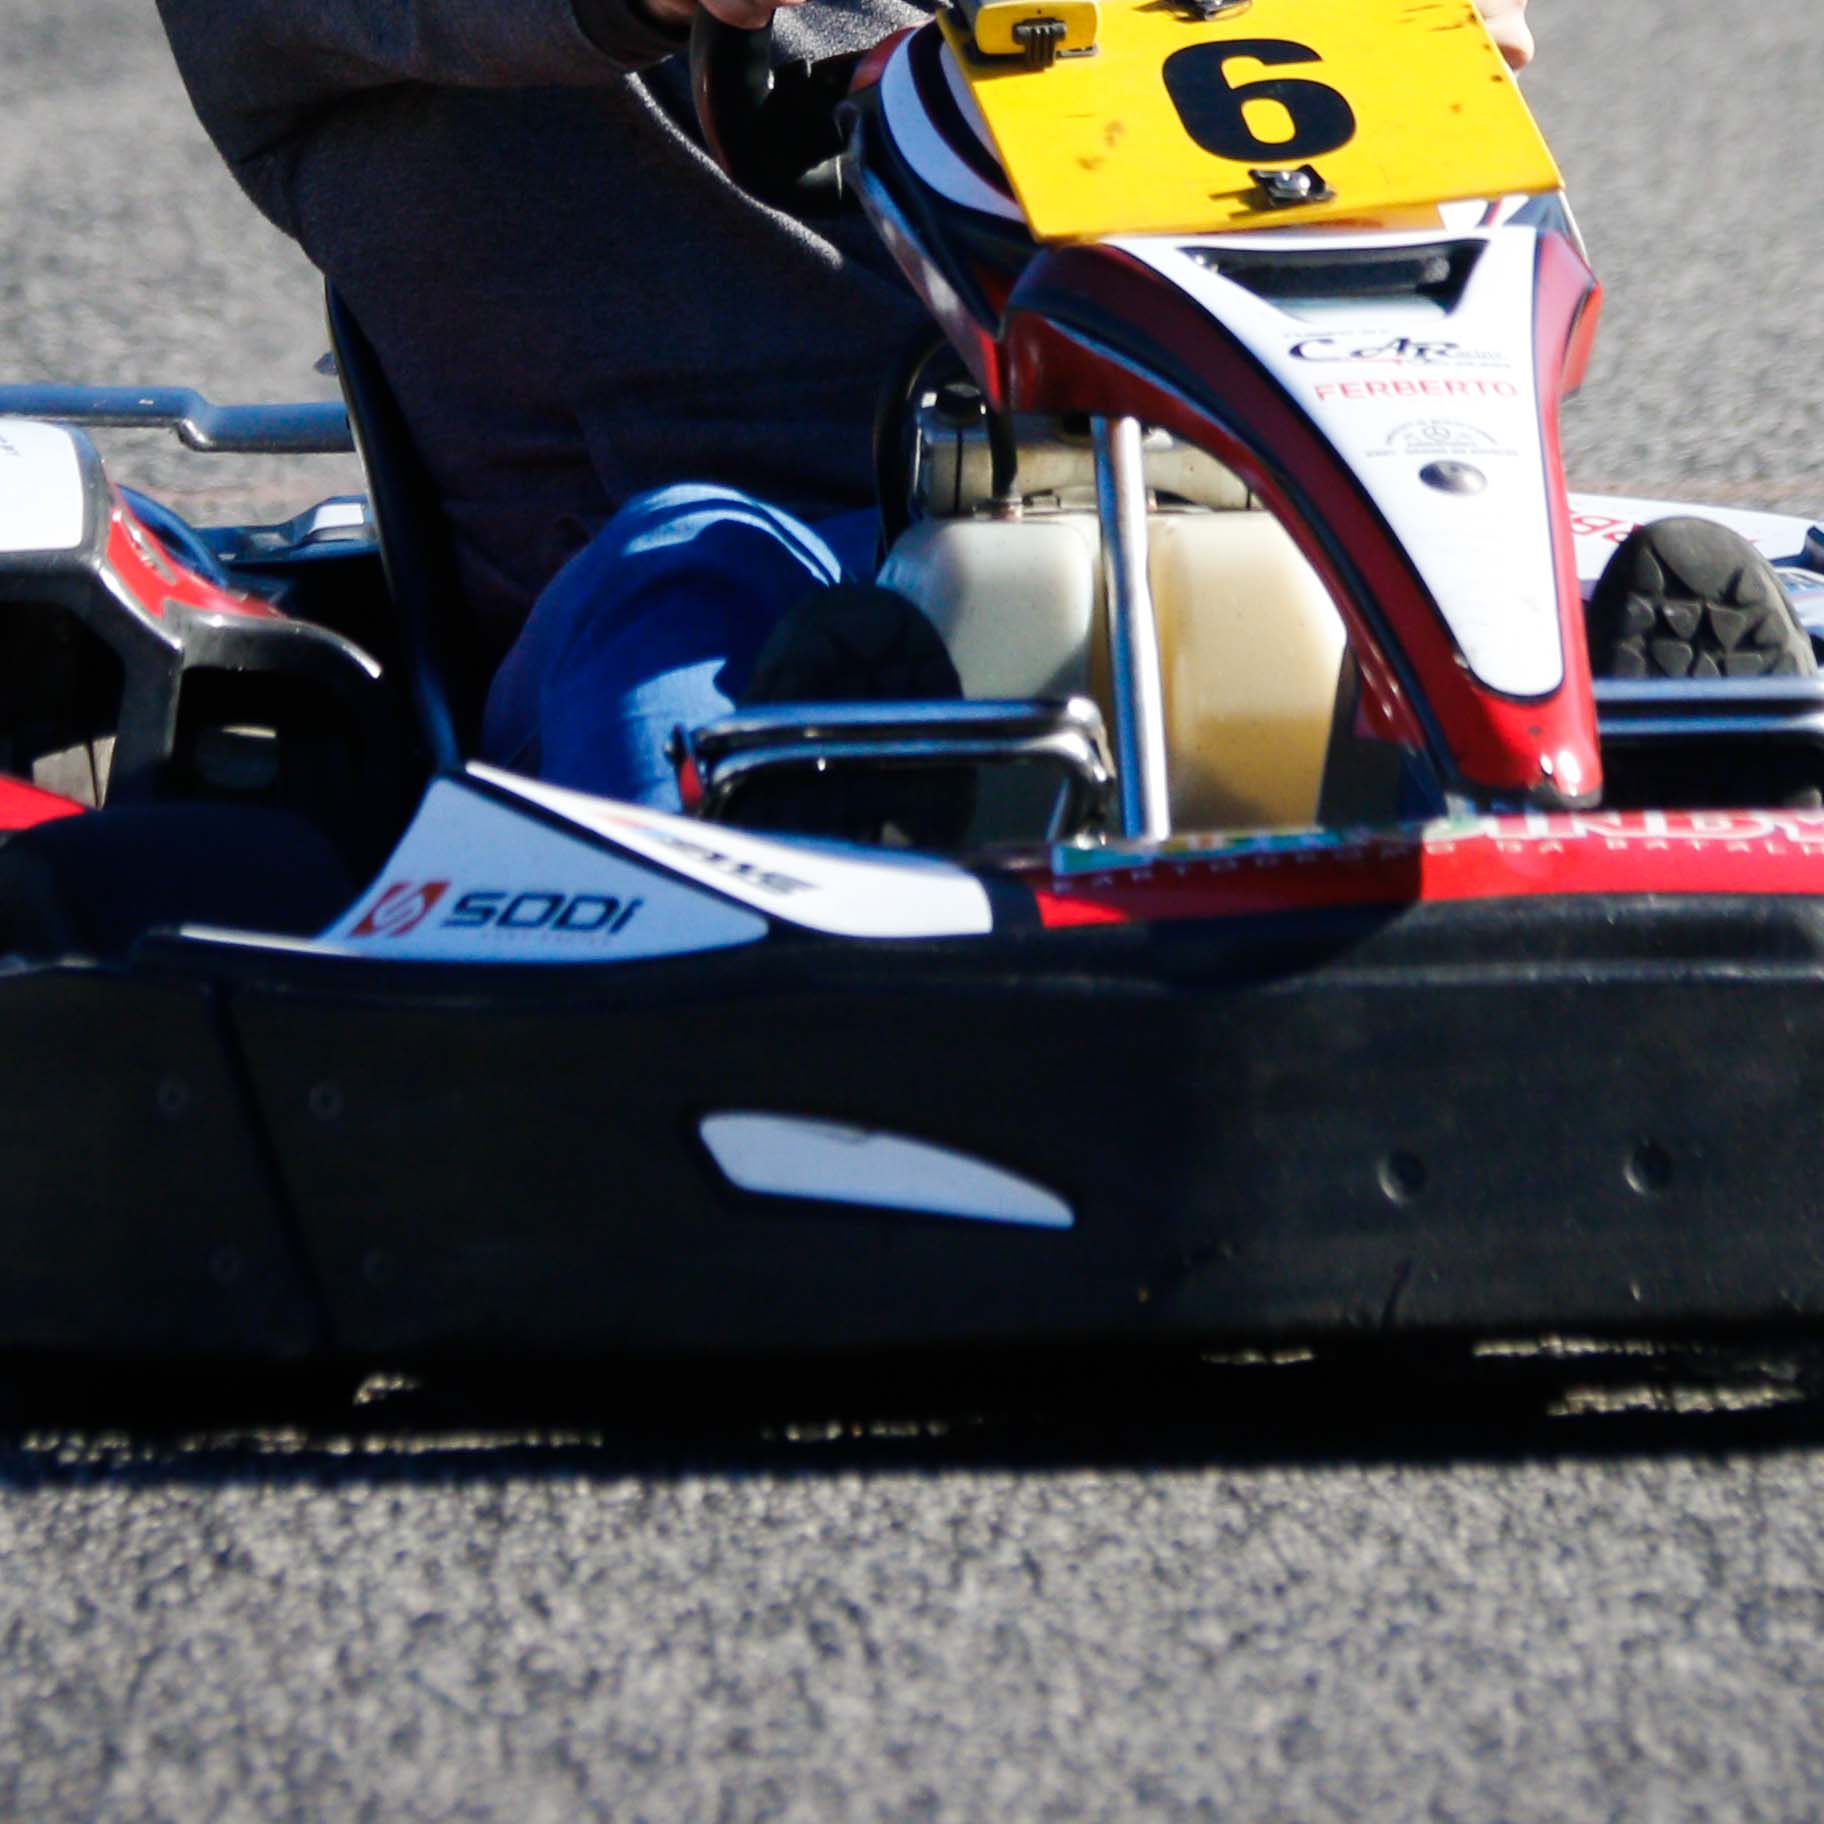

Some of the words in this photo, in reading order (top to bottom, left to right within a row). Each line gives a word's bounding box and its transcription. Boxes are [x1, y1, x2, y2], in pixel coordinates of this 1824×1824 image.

[1162, 38, 1356, 161] 6
[1313, 378, 1519, 402] FERBERTO
[441, 891, 645, 935] SODI
